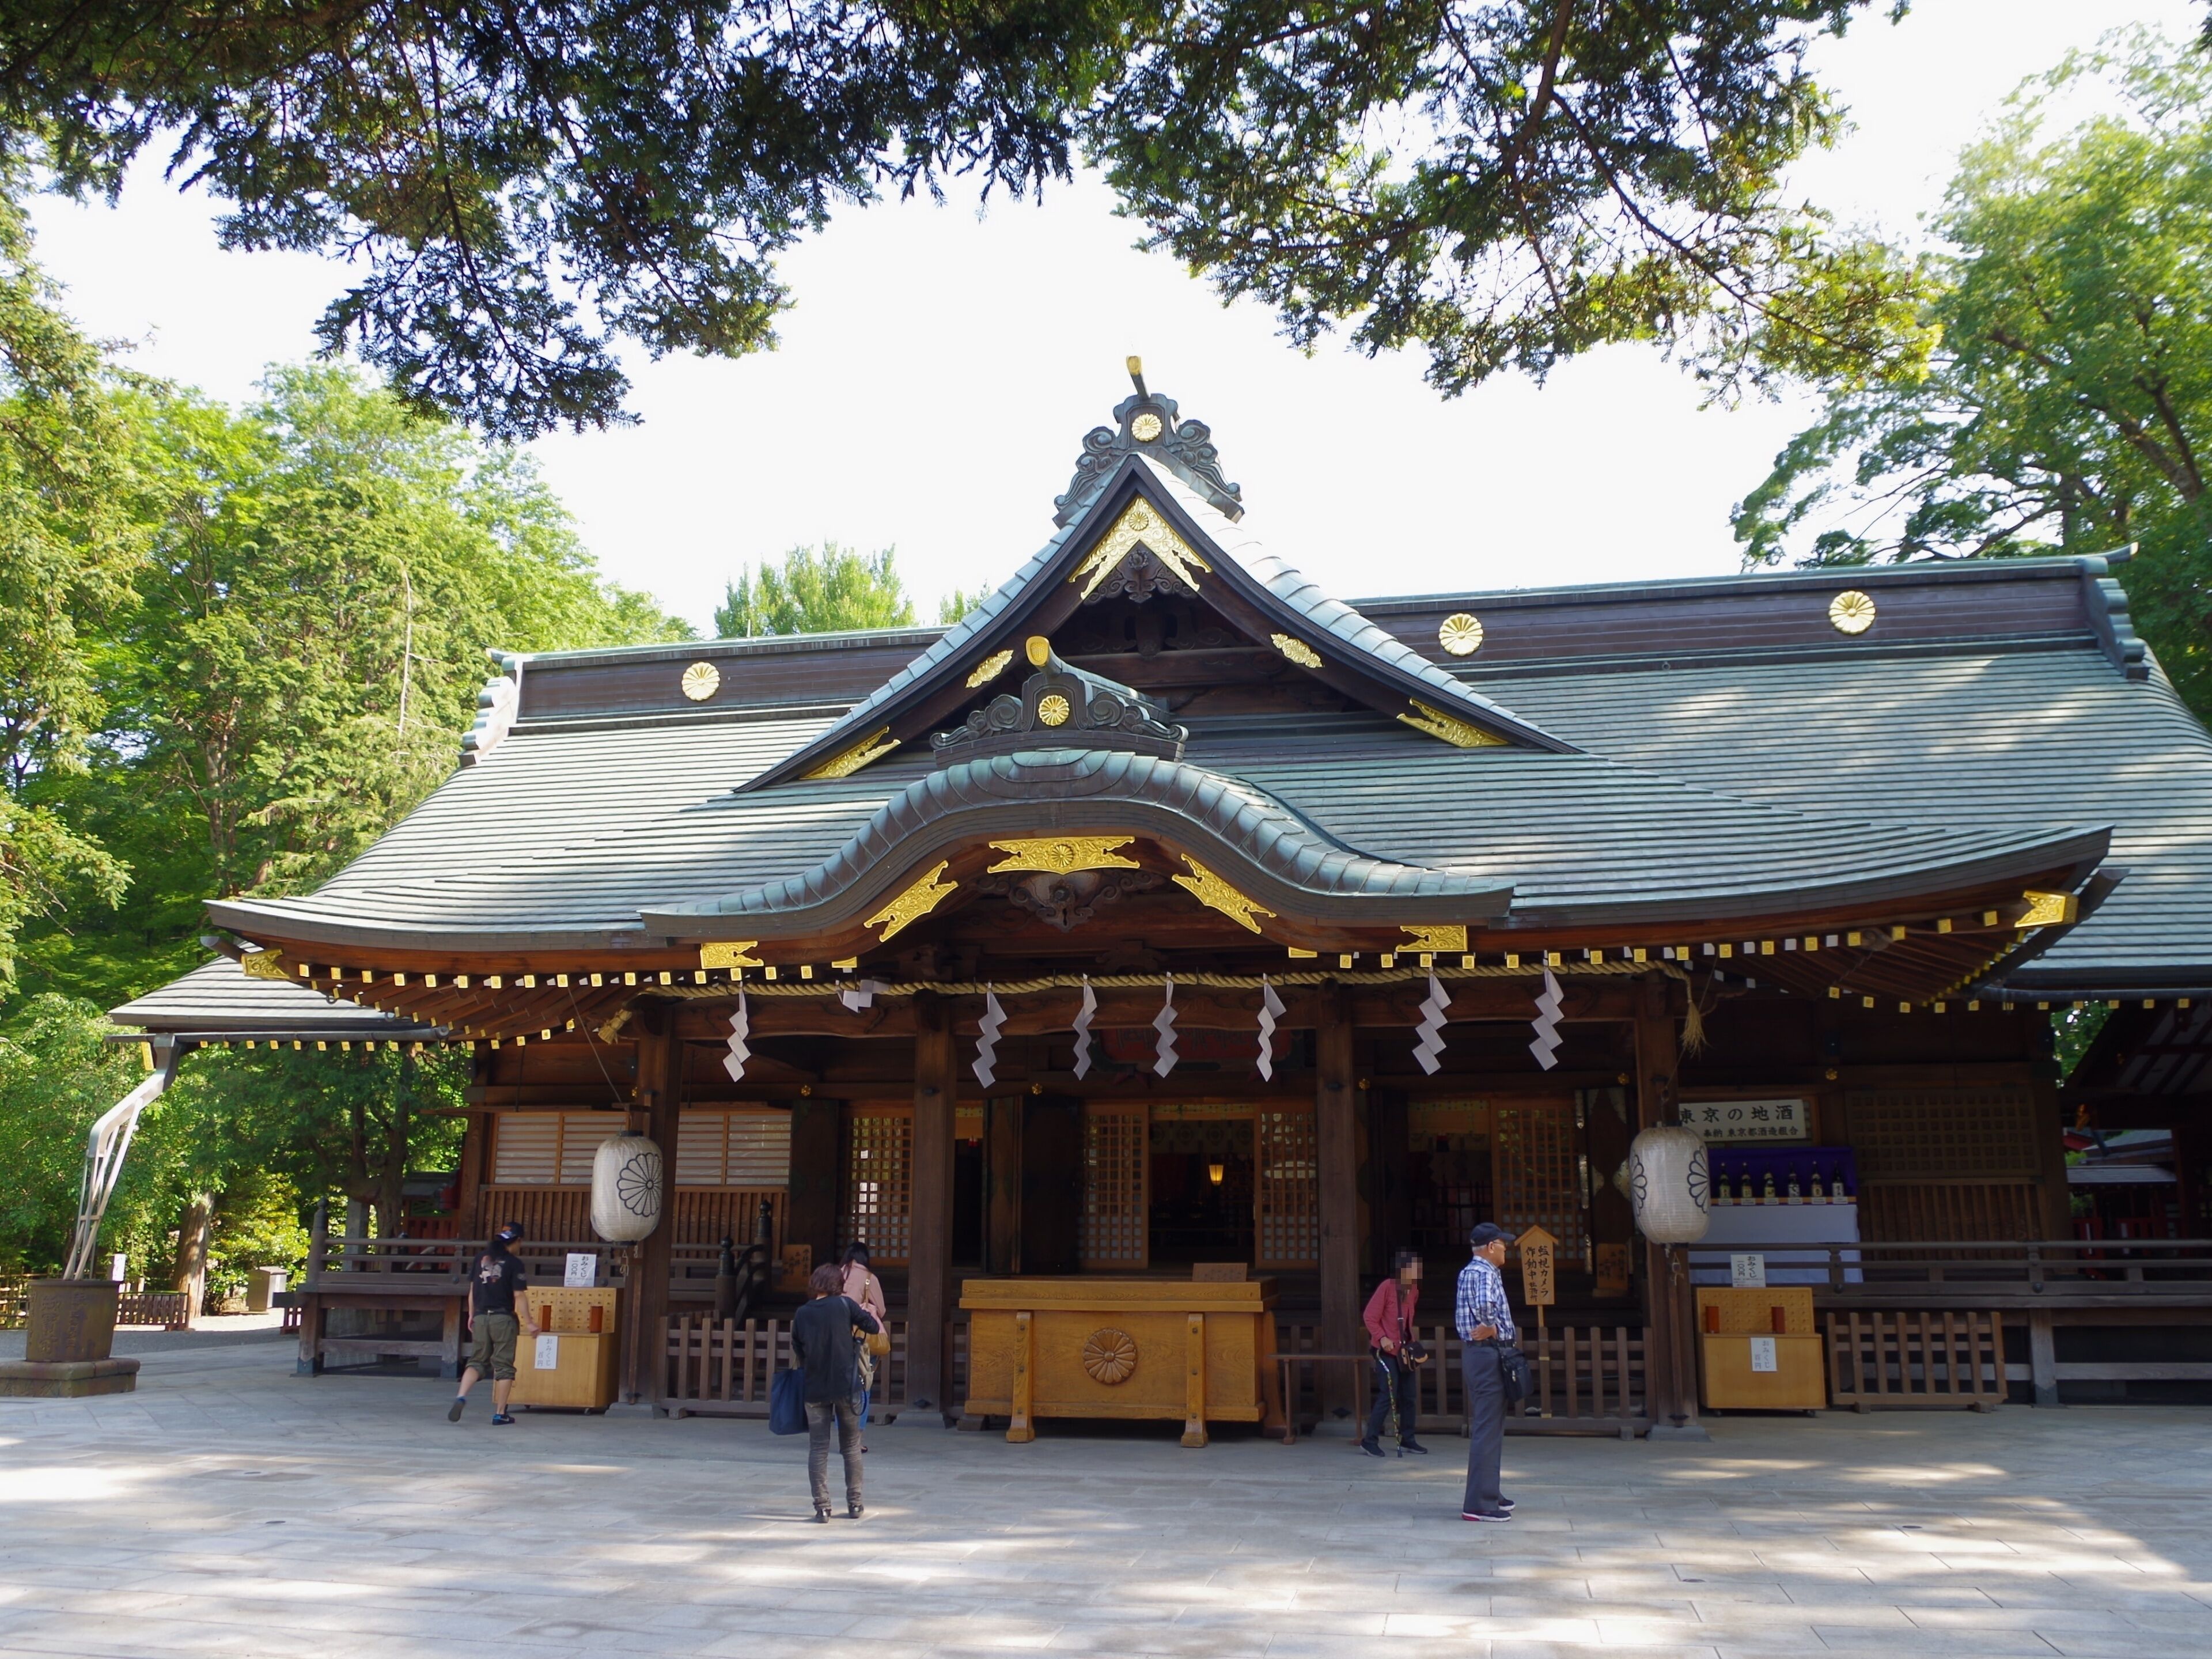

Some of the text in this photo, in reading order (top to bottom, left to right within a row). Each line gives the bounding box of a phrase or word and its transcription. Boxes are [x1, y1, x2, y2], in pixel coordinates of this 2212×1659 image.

[1680, 1105, 1793, 1123] 東京の地酒
[1704, 1126, 1798, 1138] 奉納 東京都酒造組合
[581, 1256, 589, 1278] おみくじ
[1525, 1246, 1537, 1280] 作動中
[1539, 1245, 1550, 1297] 監視カメラ
[1748, 1256, 1757, 1278] おみくじ
[1762, 1340, 1770, 1368] おみくじ
